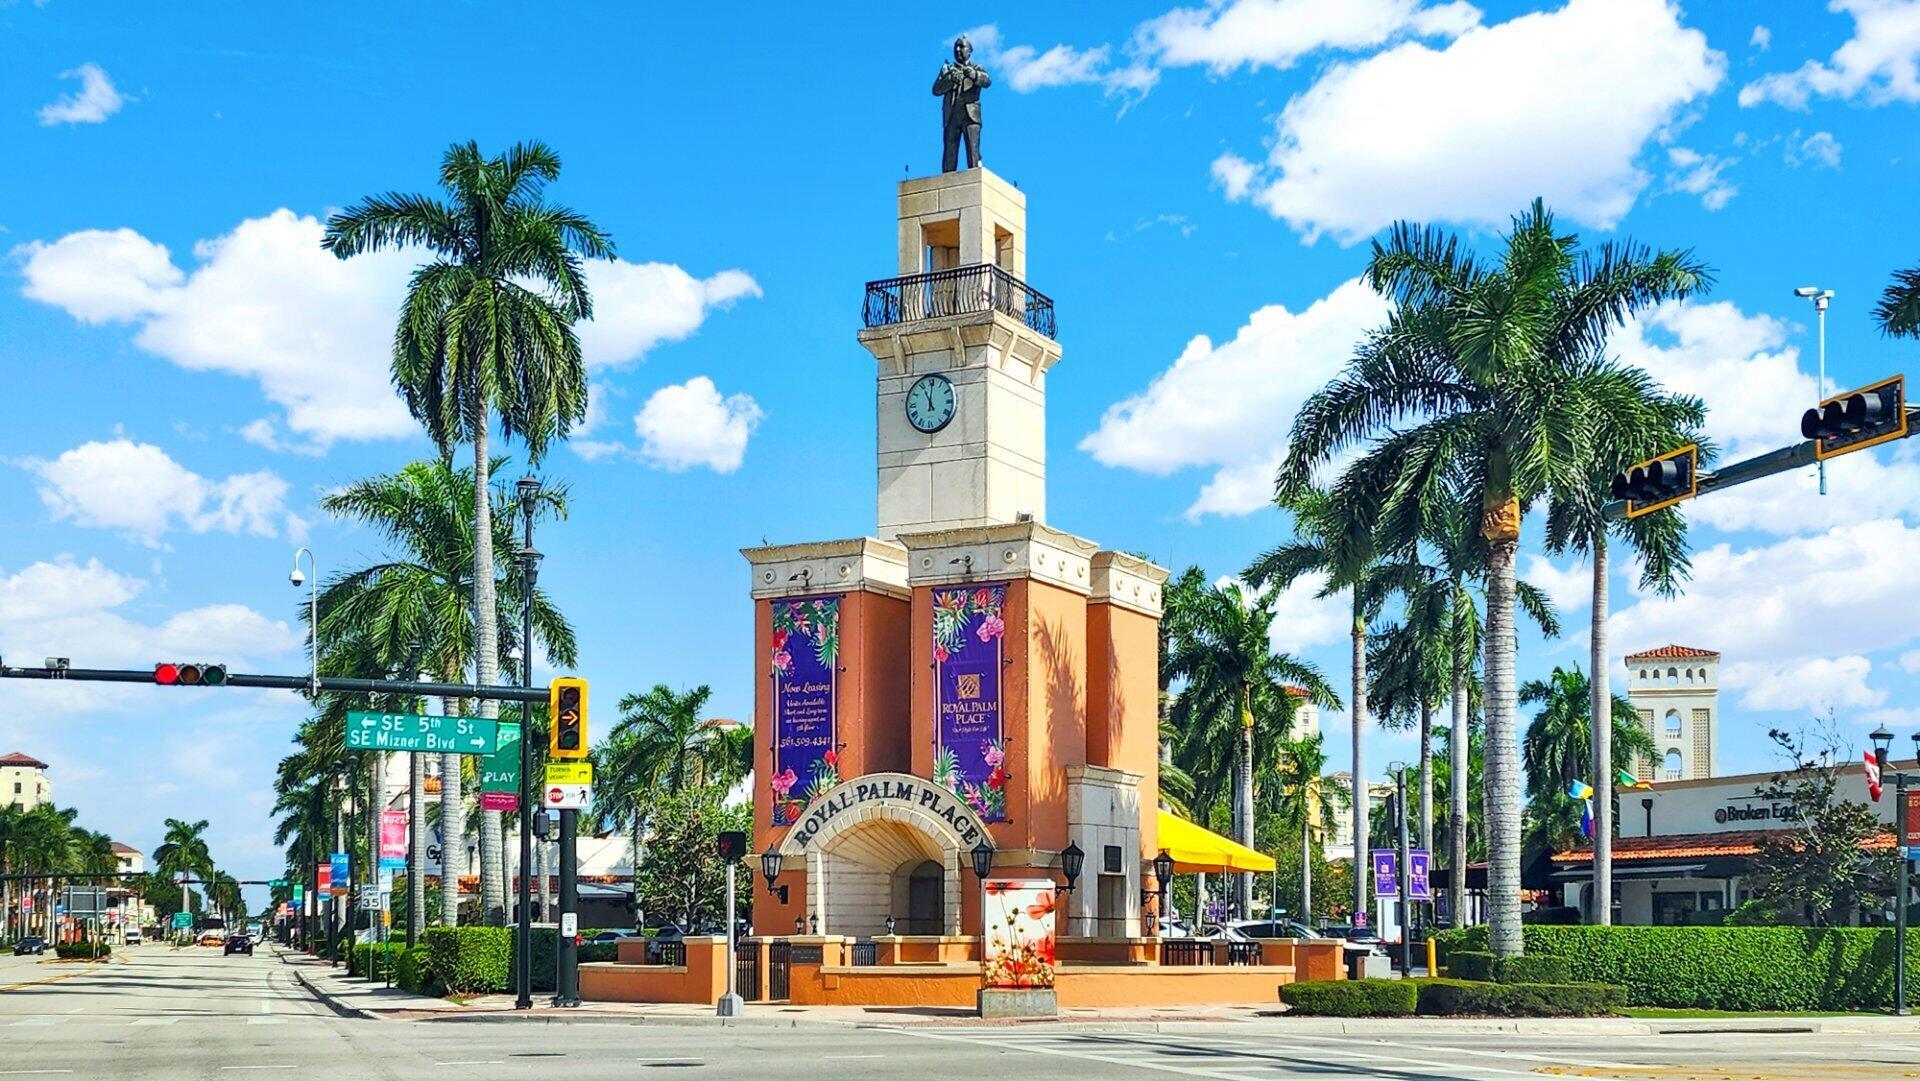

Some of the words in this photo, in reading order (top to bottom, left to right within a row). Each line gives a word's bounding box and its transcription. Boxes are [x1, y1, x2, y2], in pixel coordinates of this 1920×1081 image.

[802, 682, 831, 694] Leasing
[942, 701, 970, 713] ROYAL
[971, 701, 997, 712] PALM
[381, 715, 405, 731] SE
[419, 716, 441, 732] 5th
[457, 719, 474, 734] St
[955, 713, 985, 724] PLACE
[350, 730, 371, 746] SE
[377, 731, 420, 748] Mizner
[427, 733, 455, 749] Blvd
[485, 771, 516, 784] PLAY
[548, 792, 565, 800] STOP
[794, 791, 854, 848] ROYAL
[856, 781, 914, 803] PALM
[919, 788, 979, 845] PLACE
[1727, 803, 1770, 821] Broken
[363, 898, 380, 908] 35
